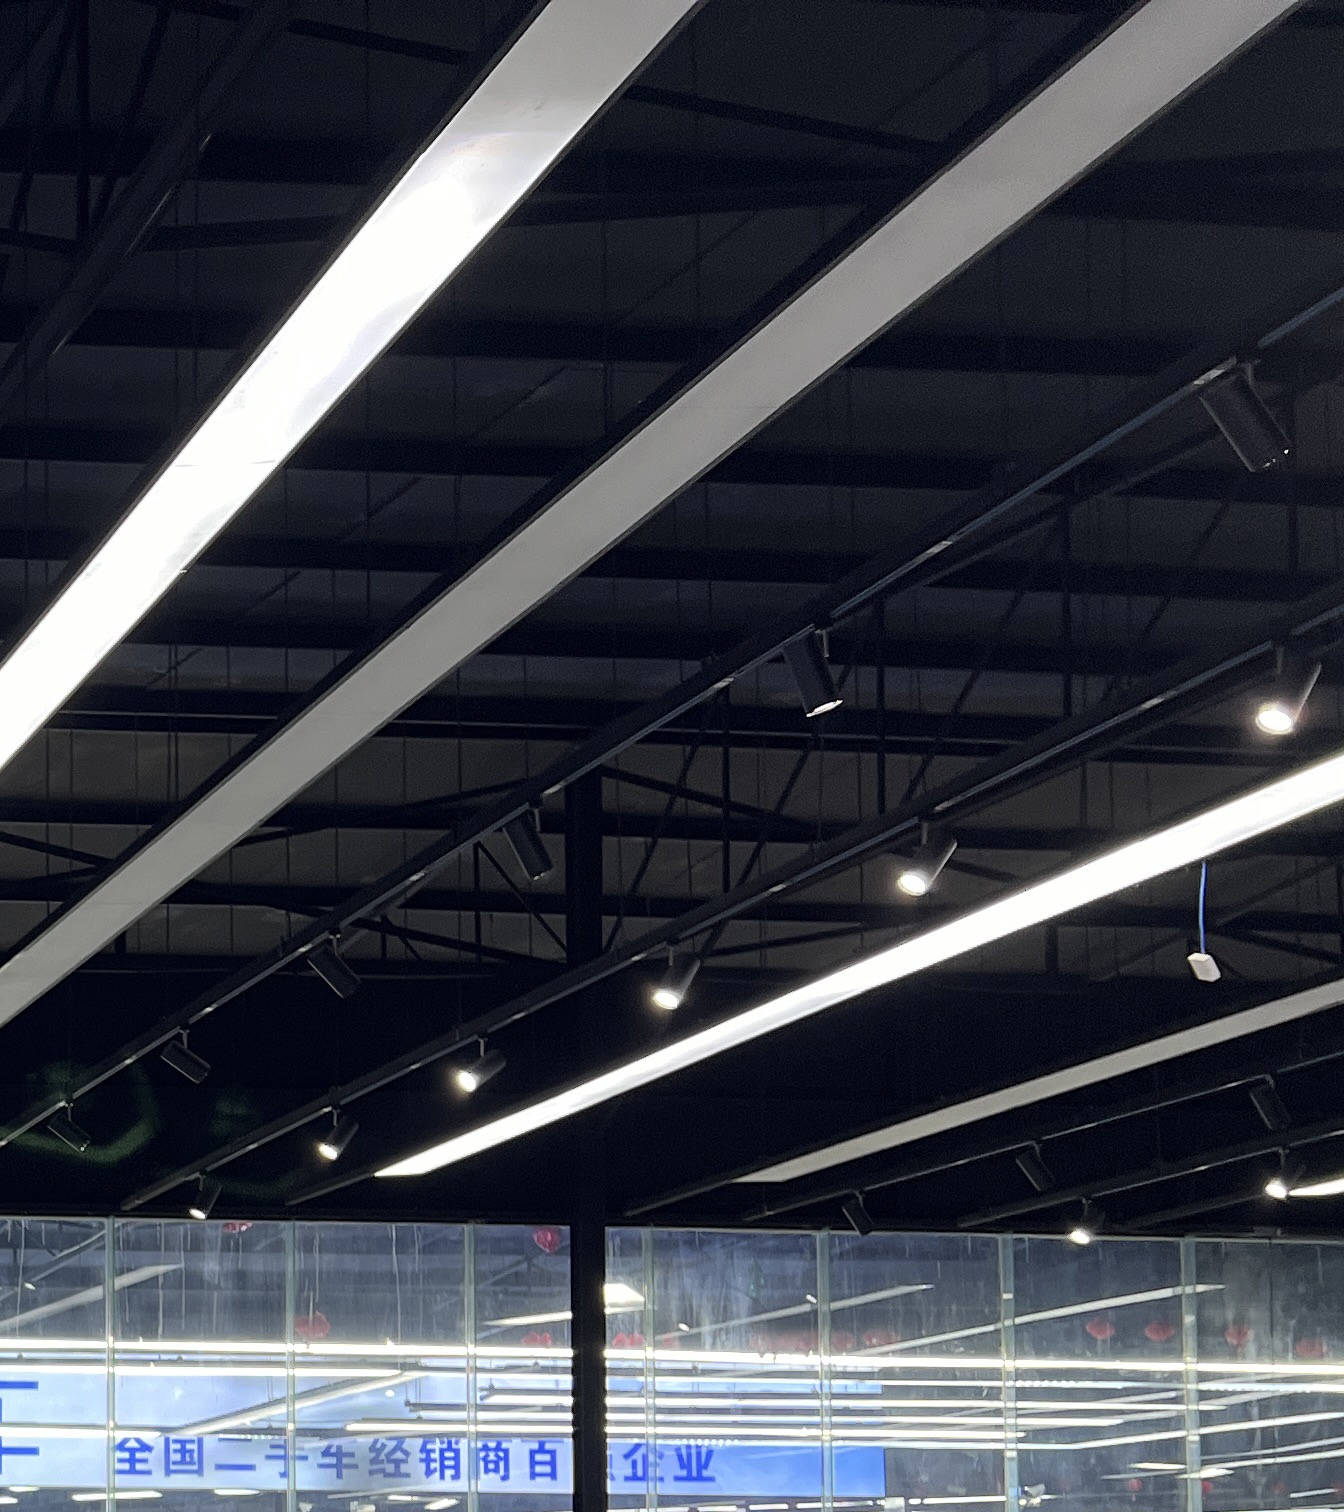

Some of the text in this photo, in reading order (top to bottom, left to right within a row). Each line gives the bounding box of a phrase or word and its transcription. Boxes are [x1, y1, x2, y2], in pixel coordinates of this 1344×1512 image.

[115, 1436, 716, 1483] 全国二手车经销商百企业
